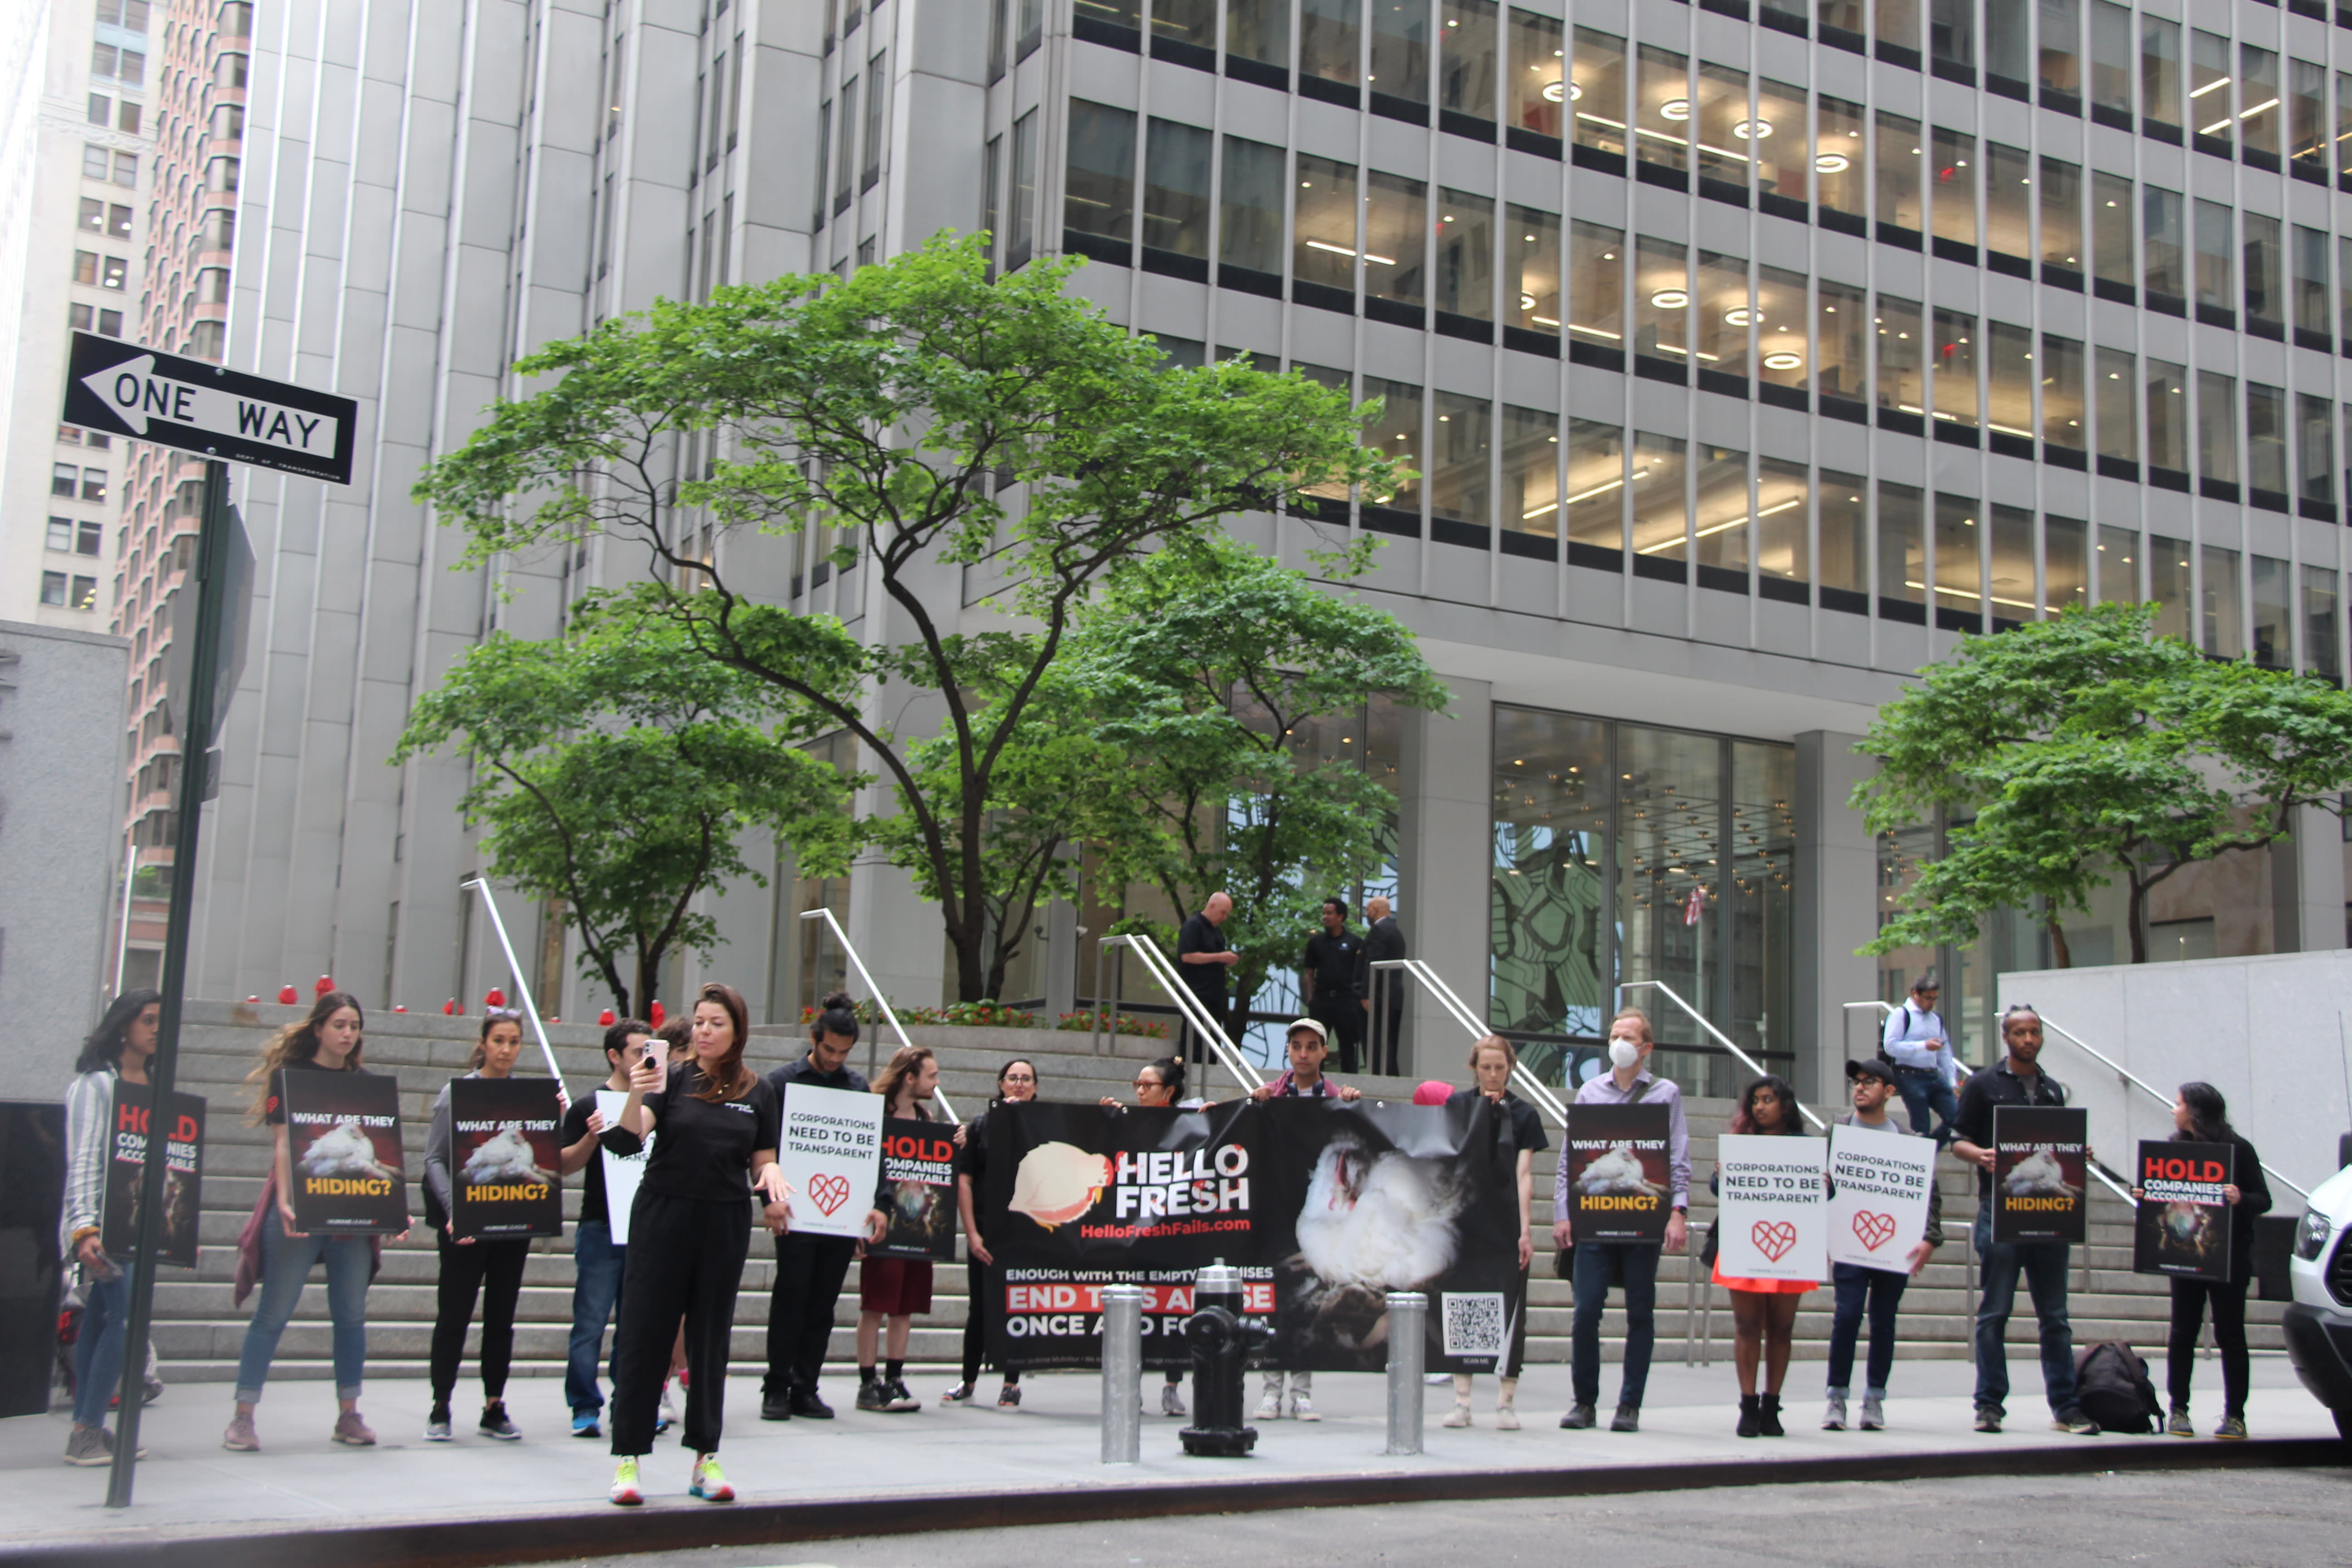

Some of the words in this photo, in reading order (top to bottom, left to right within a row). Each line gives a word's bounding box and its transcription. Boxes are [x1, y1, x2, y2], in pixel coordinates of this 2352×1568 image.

[115, 373, 196, 422] ONE
[238, 401, 321, 448] WAY
[278, 463, 340, 480] TRANSPORTATION
[118, 1103, 198, 1142] HD
[293, 1112, 333, 1124] WHAT
[335, 1114, 361, 1125] ARE
[363, 1116, 395, 1127] THEY
[456, 1121, 496, 1132] WHAT
[497, 1121, 523, 1131] ARE
[524, 1120, 557, 1131] THEY
[791, 1112, 875, 1130] CORPORATIONS
[789, 1126, 828, 1140] NEED
[833, 1131, 852, 1142] TO
[857, 1134, 875, 1146] BE
[1572, 1140, 1607, 1150] WHAT
[1609, 1140, 1633, 1149] ARE
[1635, 1140, 1666, 1150] THEY
[117, 1132, 196, 1159] COMNIES
[789, 1142, 873, 1159] TRANSPARENT
[1999, 1142, 2031, 1152] WHAT
[2033, 1143, 2053, 1152] ARE
[2055, 1143, 2082, 1153] THEY
[884, 1157, 952, 1175] OMPANIES
[1115, 1144, 1249, 1184] HELLO
[1726, 1163, 1819, 1173] CORPORATIONS
[1837, 1152, 1926, 1173] CORPORATIONS
[2145, 1157, 2225, 1183] HOLD
[1726, 1176, 1768, 1187] NEED
[1773, 1177, 1794, 1188] TO
[1800, 1178, 1819, 1189] BE
[1835, 1164, 1876, 1179] NEED
[1881, 1171, 1900, 1183] TO
[1905, 1175, 1924, 1187] BE
[306, 1178, 392, 1196] HIDING?
[466, 1184, 549, 1202] HIDING?
[1833, 1178, 1922, 1200] TRANSPARENT
[2144, 1179, 2223, 1196] COMPANIES
[1116, 1178, 1250, 1218] FRESH
[1580, 1196, 1658, 1210] HIDING?
[1726, 1191, 1819, 1203] TRANSPARENT
[2005, 1197, 2075, 1211] HIDING?
[2143, 1191, 2222, 1205] ACCOUNTABLE
[1081, 1219, 1250, 1238] HelloFreshFails.com
[1006, 1269, 1069, 1280] ENOUGH
[1073, 1270, 1112, 1281] WITH
[1116, 1270, 1145, 1281] THE
[1149, 1269, 1197, 1281] EMPTY
[1009, 1286, 1077, 1309] END
[1085, 1286, 1157, 1309] TS
[1165, 1285, 1272, 1310] ASE
[1006, 1315, 1085, 1337] ONCE
